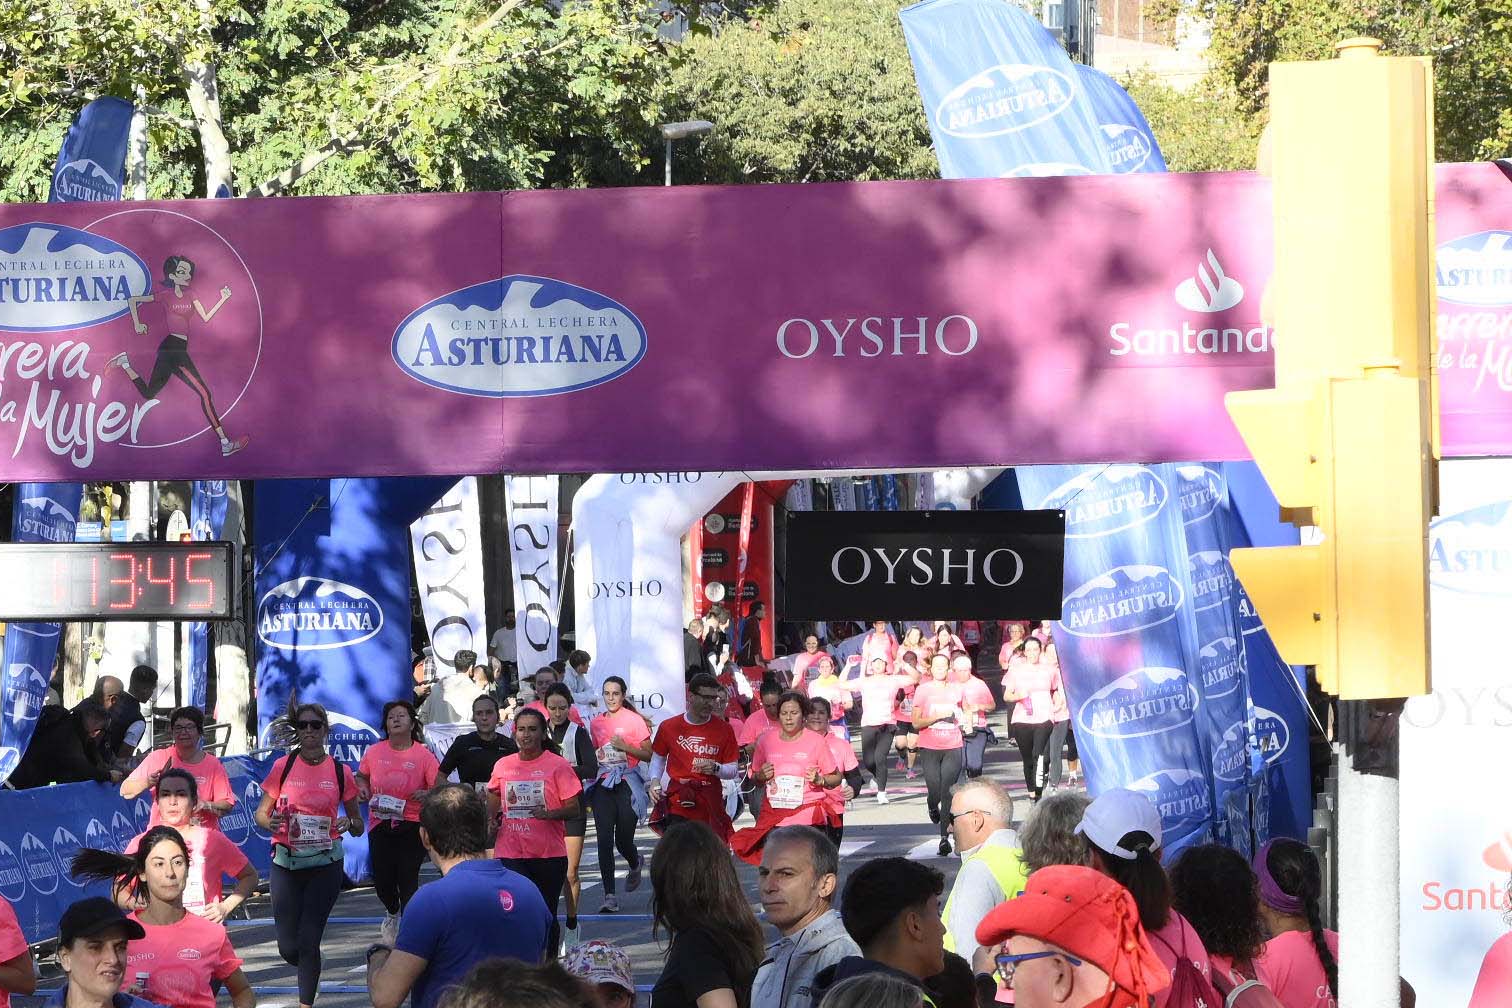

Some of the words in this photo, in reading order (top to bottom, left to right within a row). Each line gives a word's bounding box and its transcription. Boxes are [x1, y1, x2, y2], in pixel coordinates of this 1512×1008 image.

[54, 258, 127, 270] LECHERA
[451, 318, 529, 330] CENTRAL
[537, 316, 618, 328] LECHERA
[776, 315, 978, 359] OYSHO
[412, 321, 627, 367] ASTURIANA
[12, 376, 159, 468] Mujer
[831, 546, 1025, 587] OYSHO
[261, 605, 373, 634] ASTURIANA
[321, 600, 370, 610] LECHERA
[328, 733, 371, 742] ECHERA
